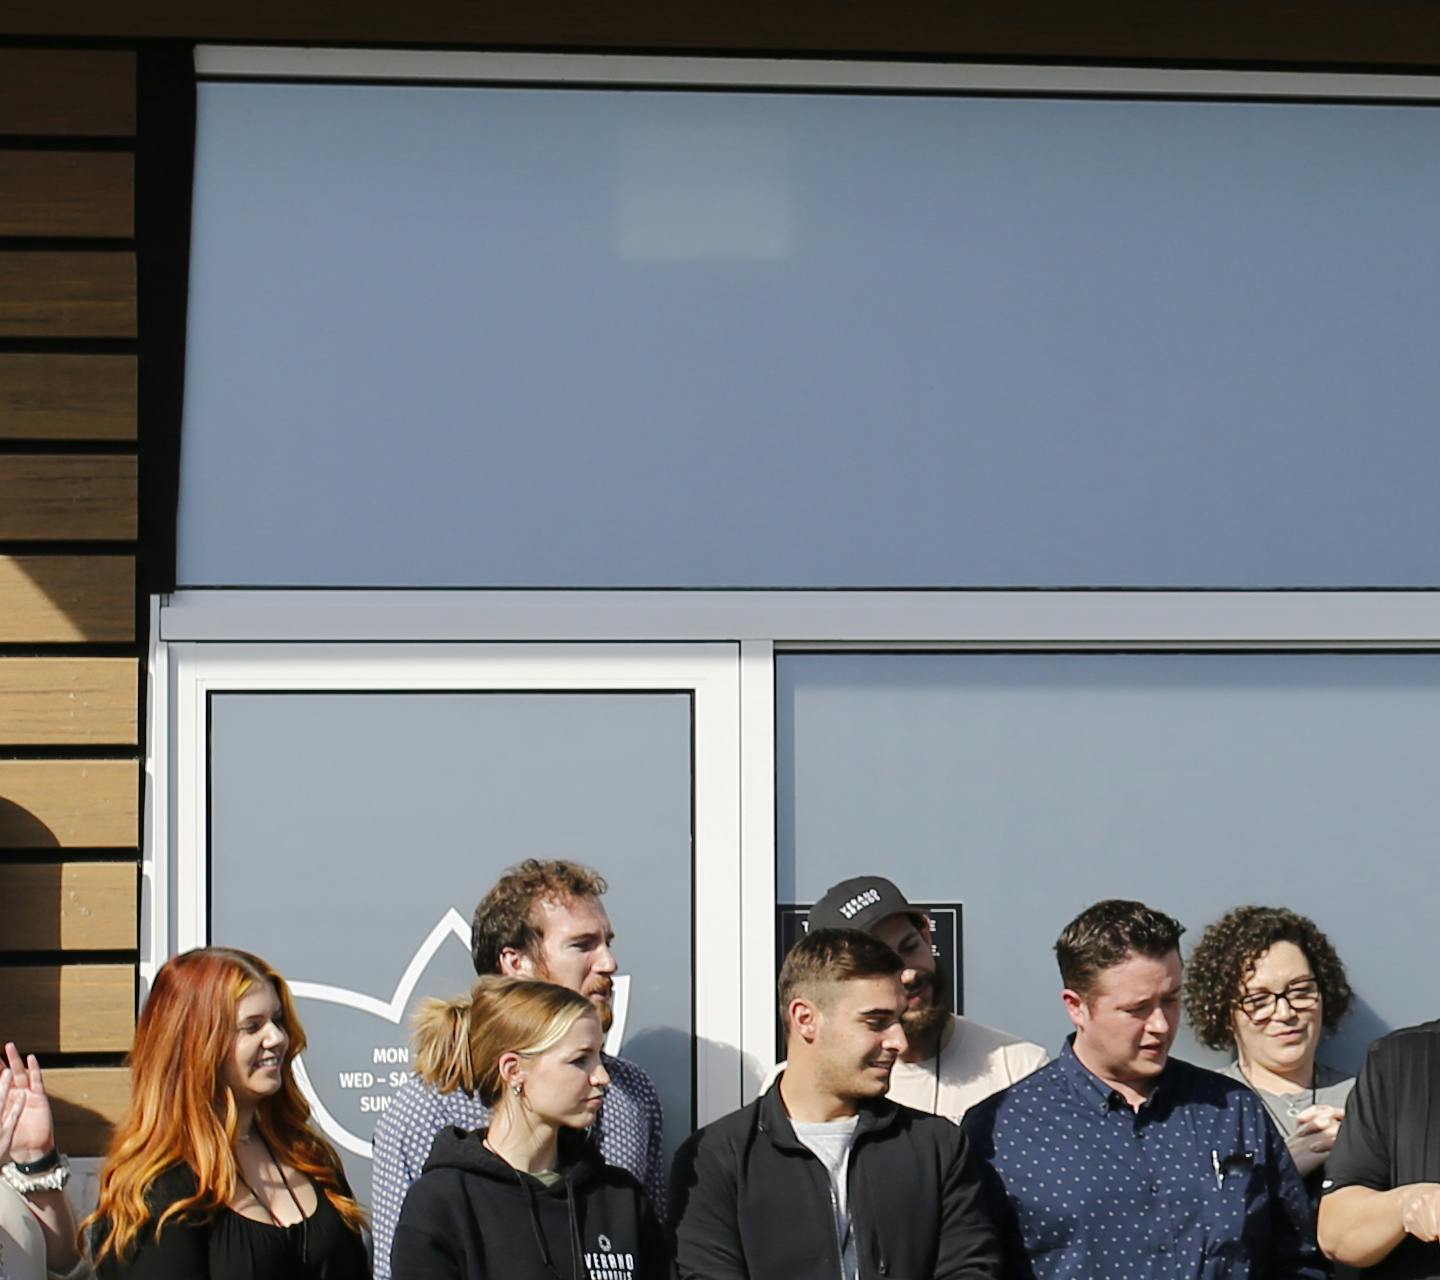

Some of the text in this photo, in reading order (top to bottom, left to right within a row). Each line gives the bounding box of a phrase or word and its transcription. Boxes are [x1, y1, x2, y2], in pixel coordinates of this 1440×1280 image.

[373, 1047, 409, 1063] MON
[339, 1072, 374, 1088] WED
[389, 1071, 415, 1088] SA
[583, 1252, 634, 1271] VERANO
